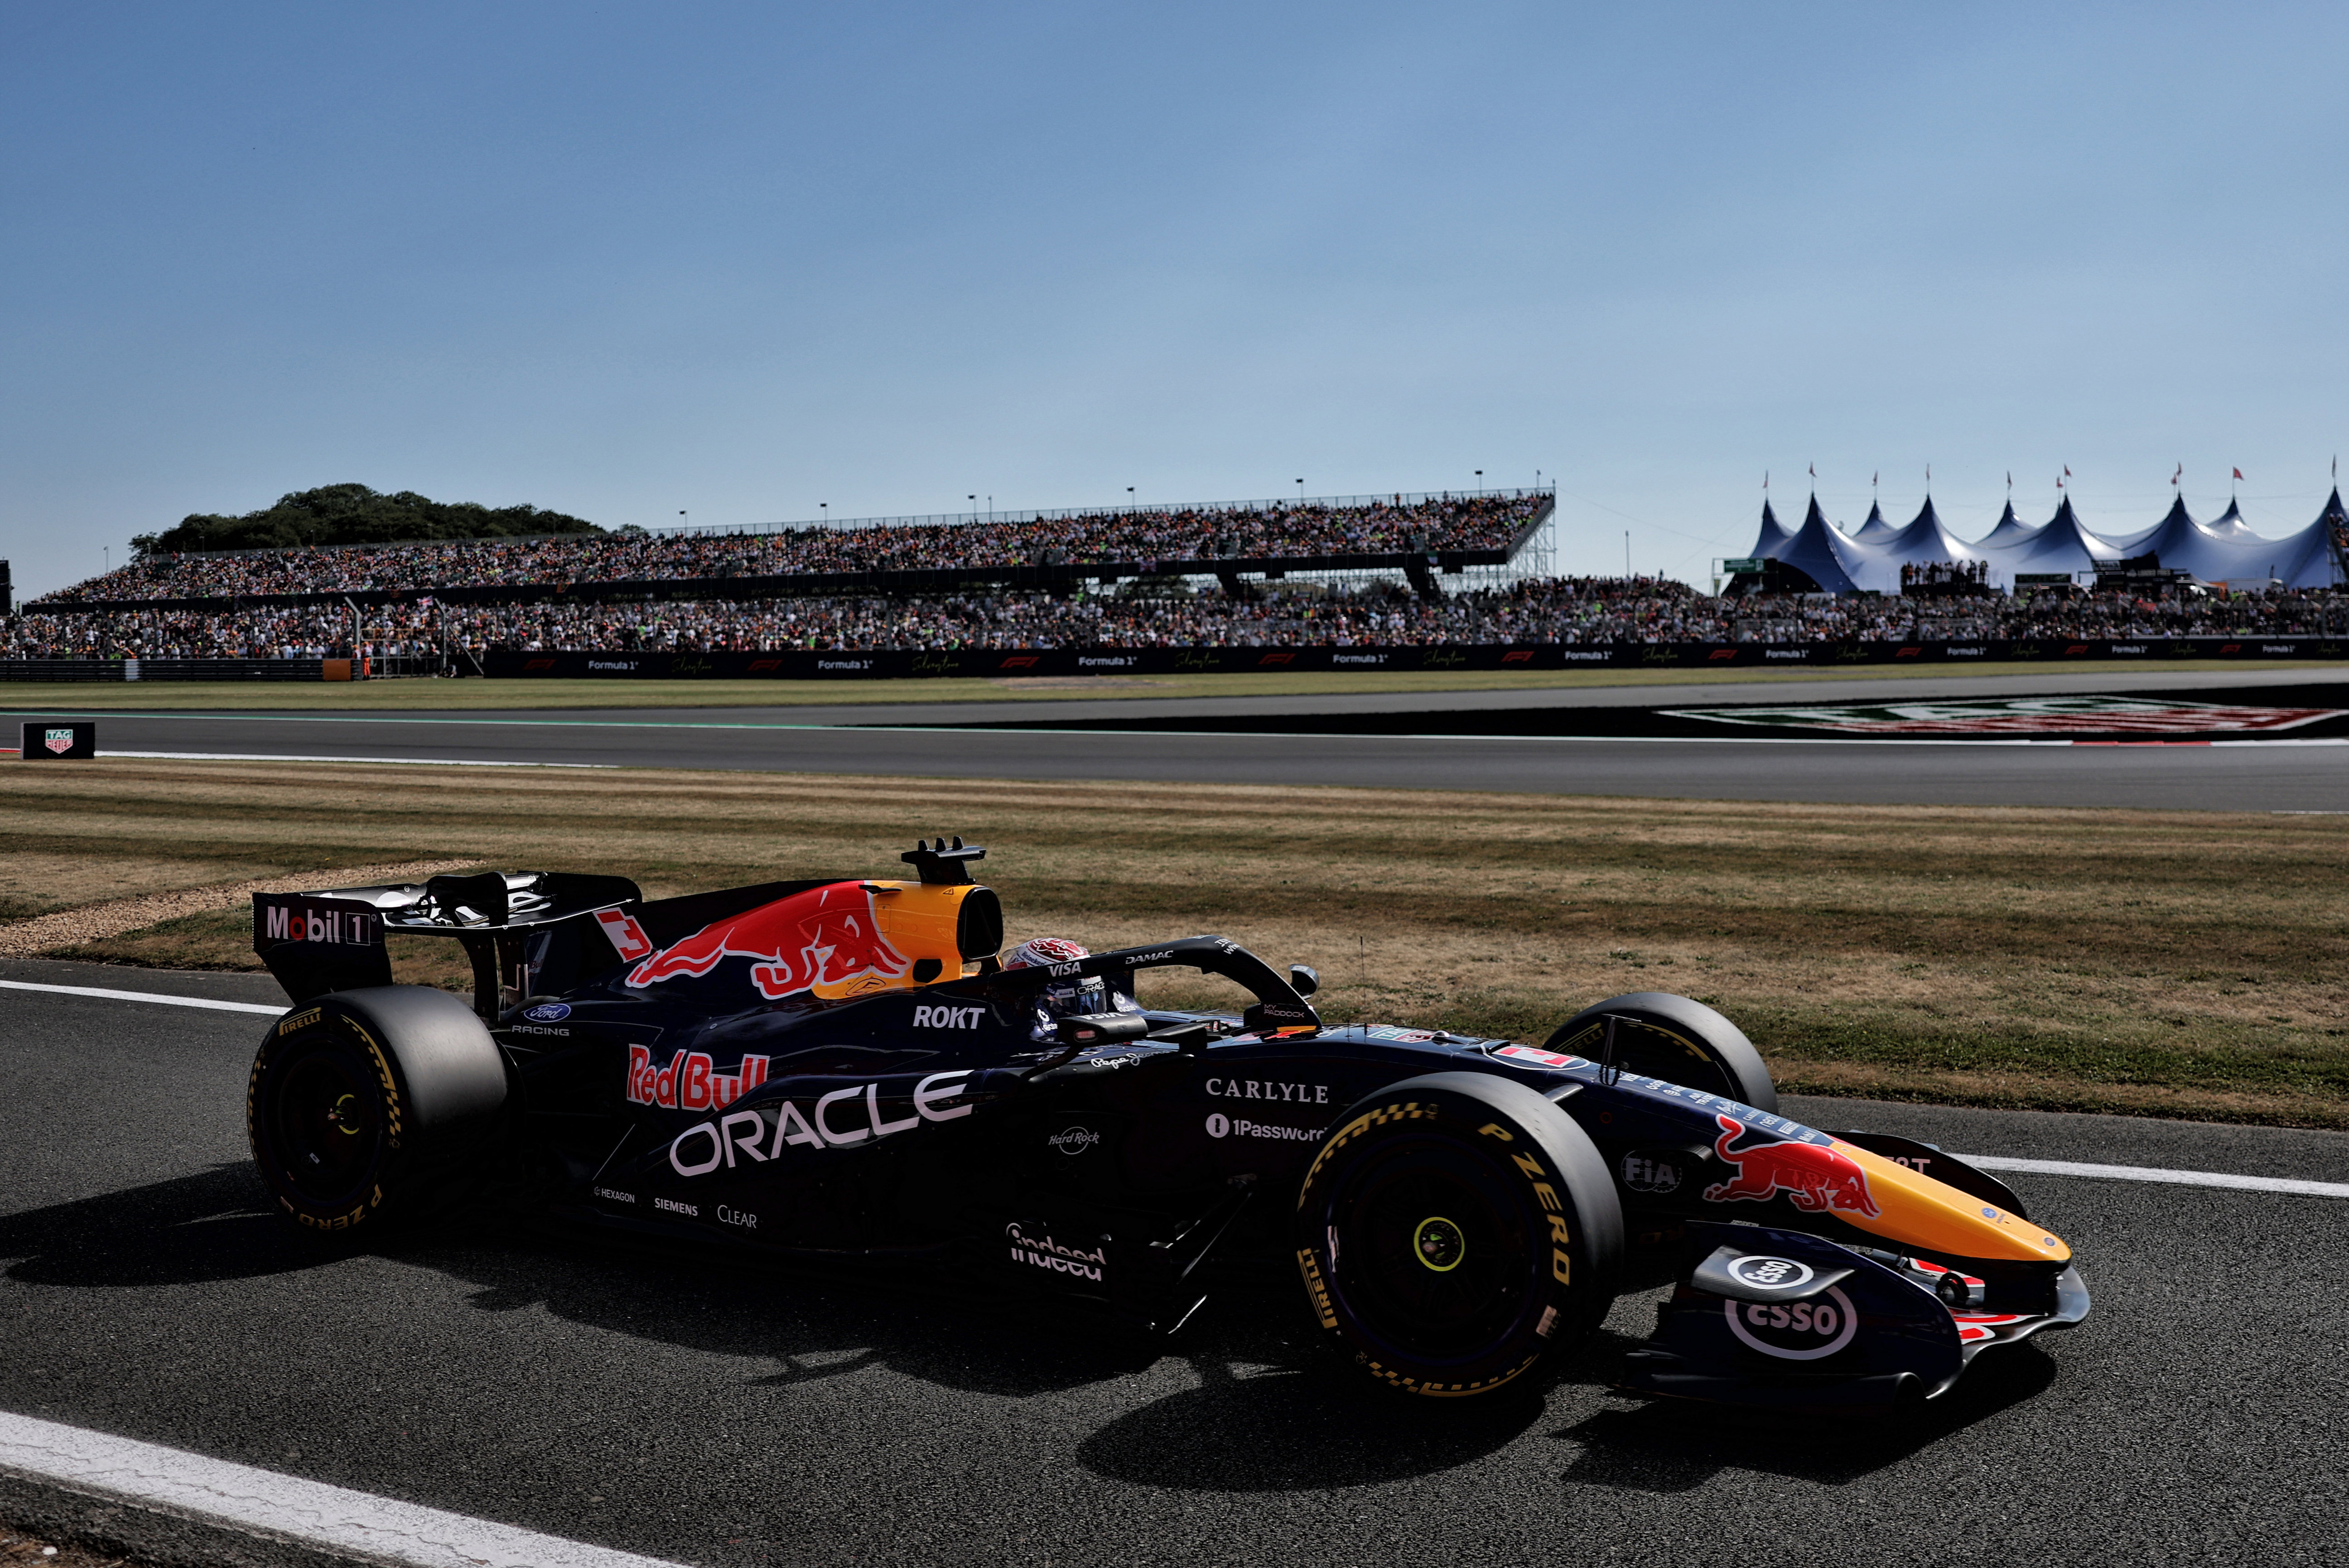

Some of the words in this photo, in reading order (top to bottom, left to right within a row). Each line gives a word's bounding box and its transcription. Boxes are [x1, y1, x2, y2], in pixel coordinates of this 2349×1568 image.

[1333, 654, 1377, 663] Formula
[1565, 651, 1603, 660] Formula
[1765, 650, 1800, 658] Formula
[1947, 647, 1978, 656] Formula
[588, 661, 628, 670] Formula
[818, 660, 861, 669] Formula
[1079, 656, 1125, 666] Formula
[267, 906, 340, 944] Mobil
[352, 916, 361, 943] 1
[1125, 950, 1174, 964] DAMAC
[1047, 962, 1082, 977] VISA
[530, 1006, 563, 1019] Ford
[913, 1005, 986, 1029] ROKT
[1264, 1009, 1305, 1018] PADDOCK
[279, 1007, 322, 1037] PIRELLI
[511, 1025, 569, 1036] RACING
[1376, 1028, 1410, 1037] TAG
[1090, 1057, 1129, 1070] Pepe
[627, 1043, 687, 1110] Red
[681, 1052, 770, 1112] Bull
[1206, 1078, 1328, 1104] CARLYLE
[669, 1070, 975, 1177] ORACLE
[1777, 1122, 1800, 1134] PIRELLI
[1048, 1133, 1075, 1145] Hard
[1074, 1132, 1100, 1144] Rock
[371, 1184, 382, 1208] P
[601, 1188, 635, 1203] HEXAGON
[654, 1197, 698, 1217] SIEMENS
[1478, 1123, 1515, 1142] P
[1511, 1151, 1571, 1286] ZERO
[299, 1205, 366, 1230] ZERO
[717, 1204, 757, 1229] CLEAR
[1006, 1222, 1107, 1282] indeed
[1297, 1248, 1338, 1329] PIRELLI
